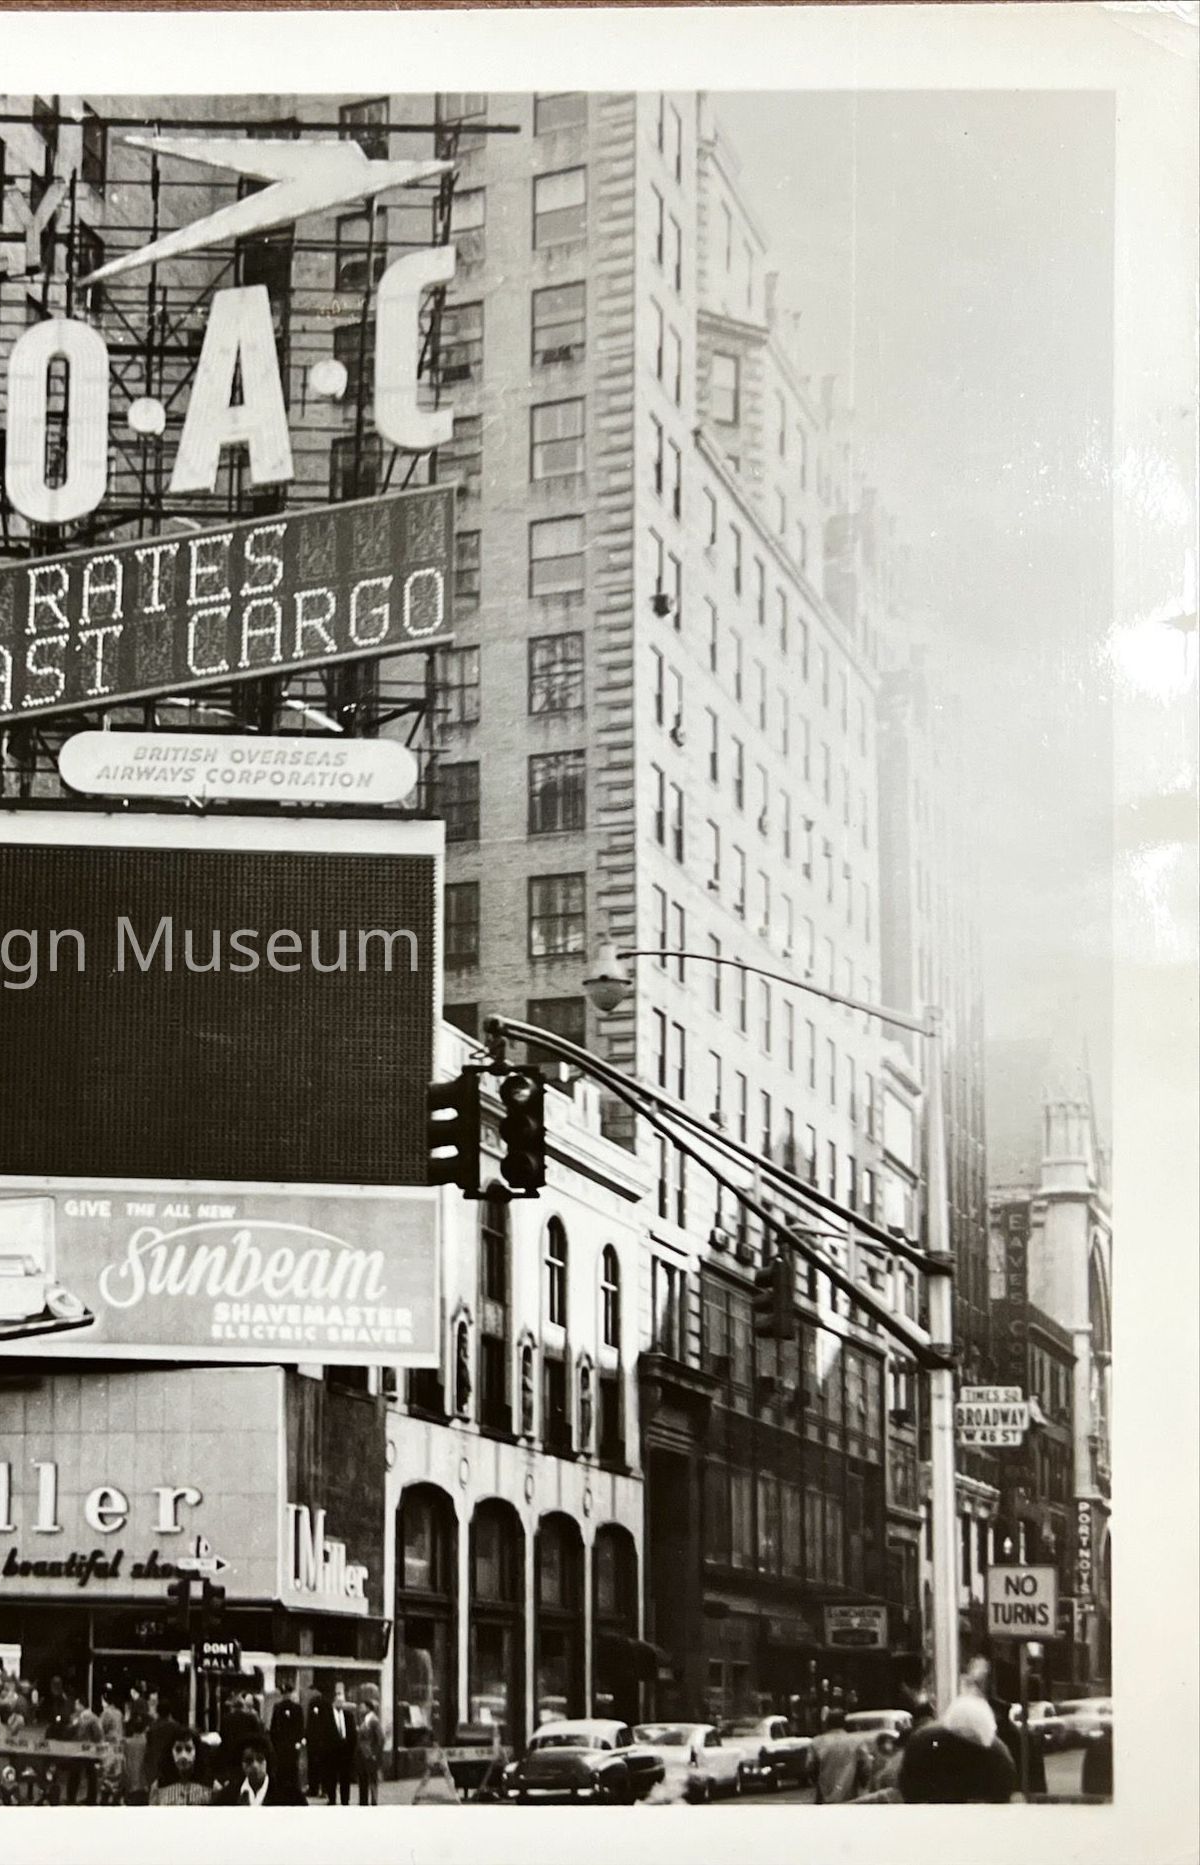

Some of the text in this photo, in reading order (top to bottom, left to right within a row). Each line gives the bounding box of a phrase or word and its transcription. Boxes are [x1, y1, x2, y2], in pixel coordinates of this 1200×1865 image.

[23, 523, 288, 635] RATES
[186, 566, 446, 677] CARGO
[132, 746, 348, 768] BRITISH OVERSEAS
[96, 765, 374, 788] AIRWAYS CORPORATION
[64, 1200, 237, 1220] GIVE THE ALL NEW
[99, 1219, 388, 1309] Sunbeam
[212, 1301, 414, 1328] SHAVEMASTER
[210, 1323, 415, 1344] ELECTRIC SHAVER
[965, 1389, 1000, 1401] TIMES
[957, 1407, 1026, 1427] BROADWAY
[964, 1430, 1018, 1442] W 46 ST
[2, 1547, 124, 1587] beautiful
[1005, 1575, 1038, 1596] NO
[991, 1603, 1050, 1626] TURNS
